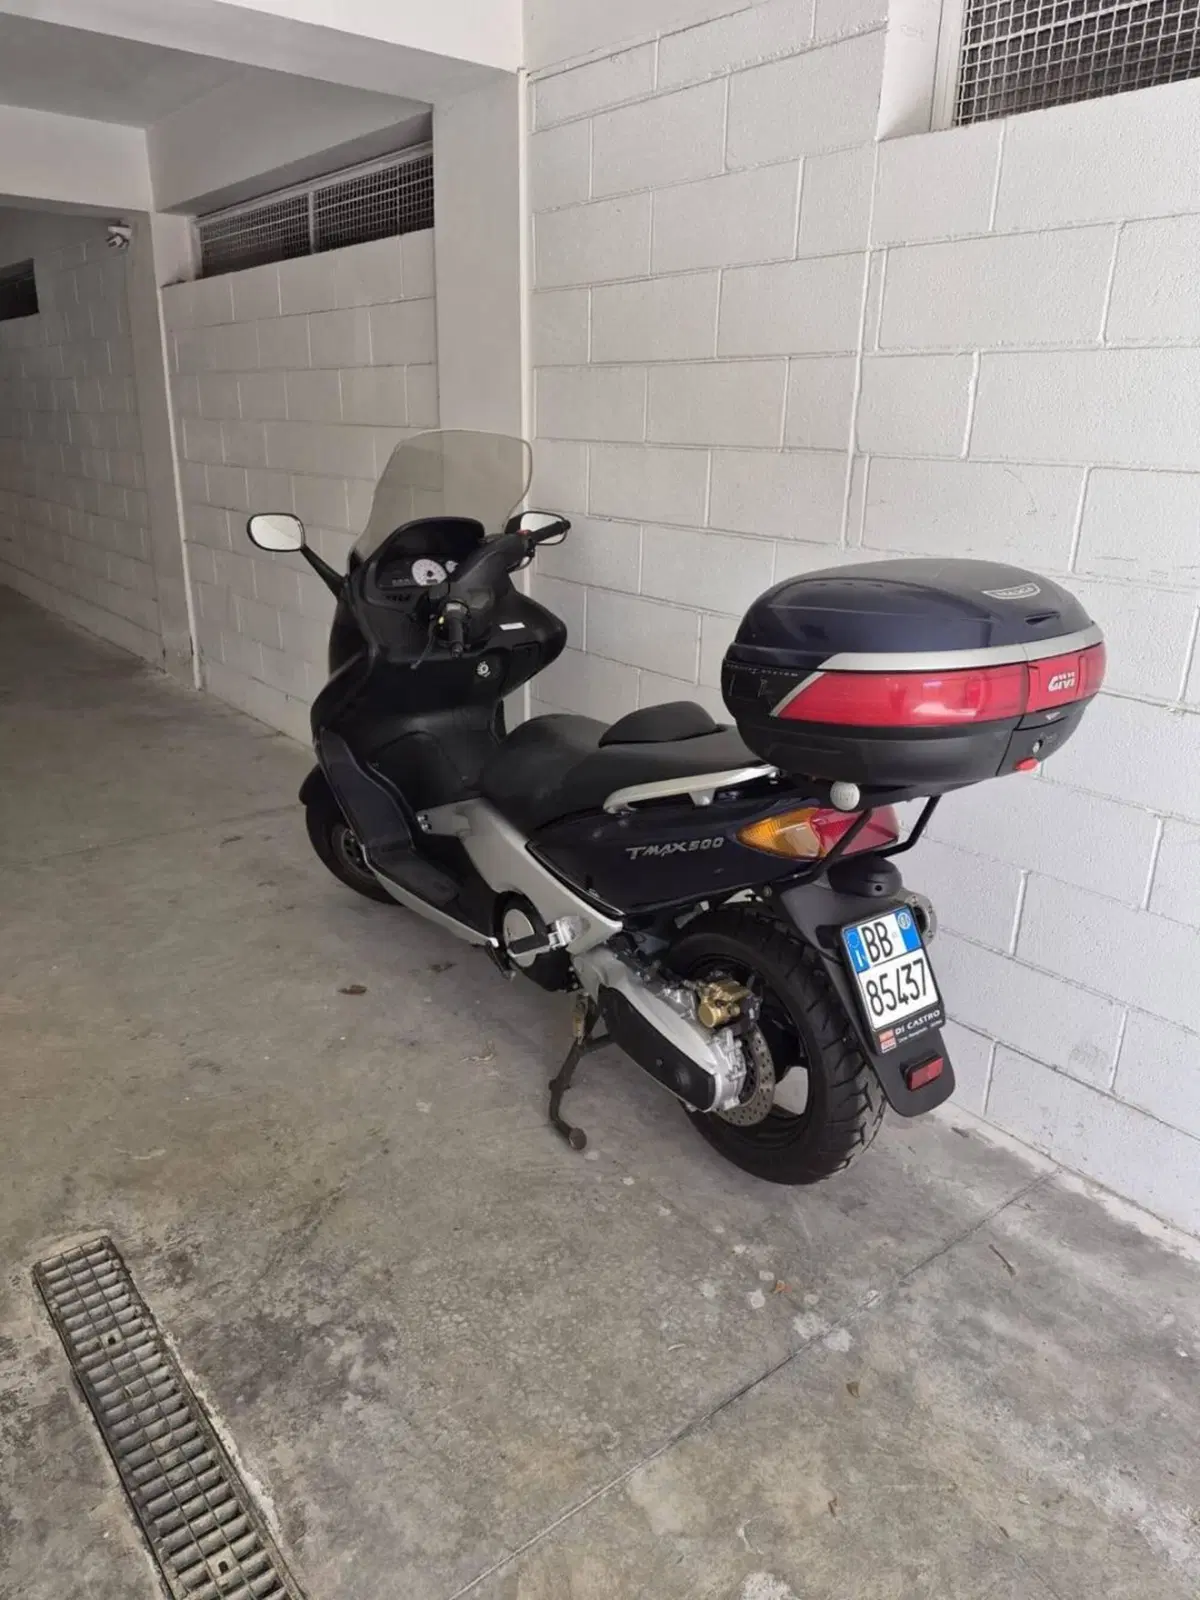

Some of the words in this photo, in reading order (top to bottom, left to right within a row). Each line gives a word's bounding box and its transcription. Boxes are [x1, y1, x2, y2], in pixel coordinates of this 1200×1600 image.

[1048, 671, 1076, 692] GIVI
[861, 921, 893, 963] BB
[866, 958, 926, 1016] 85437
[907, 1009, 940, 1030] CASTRO
